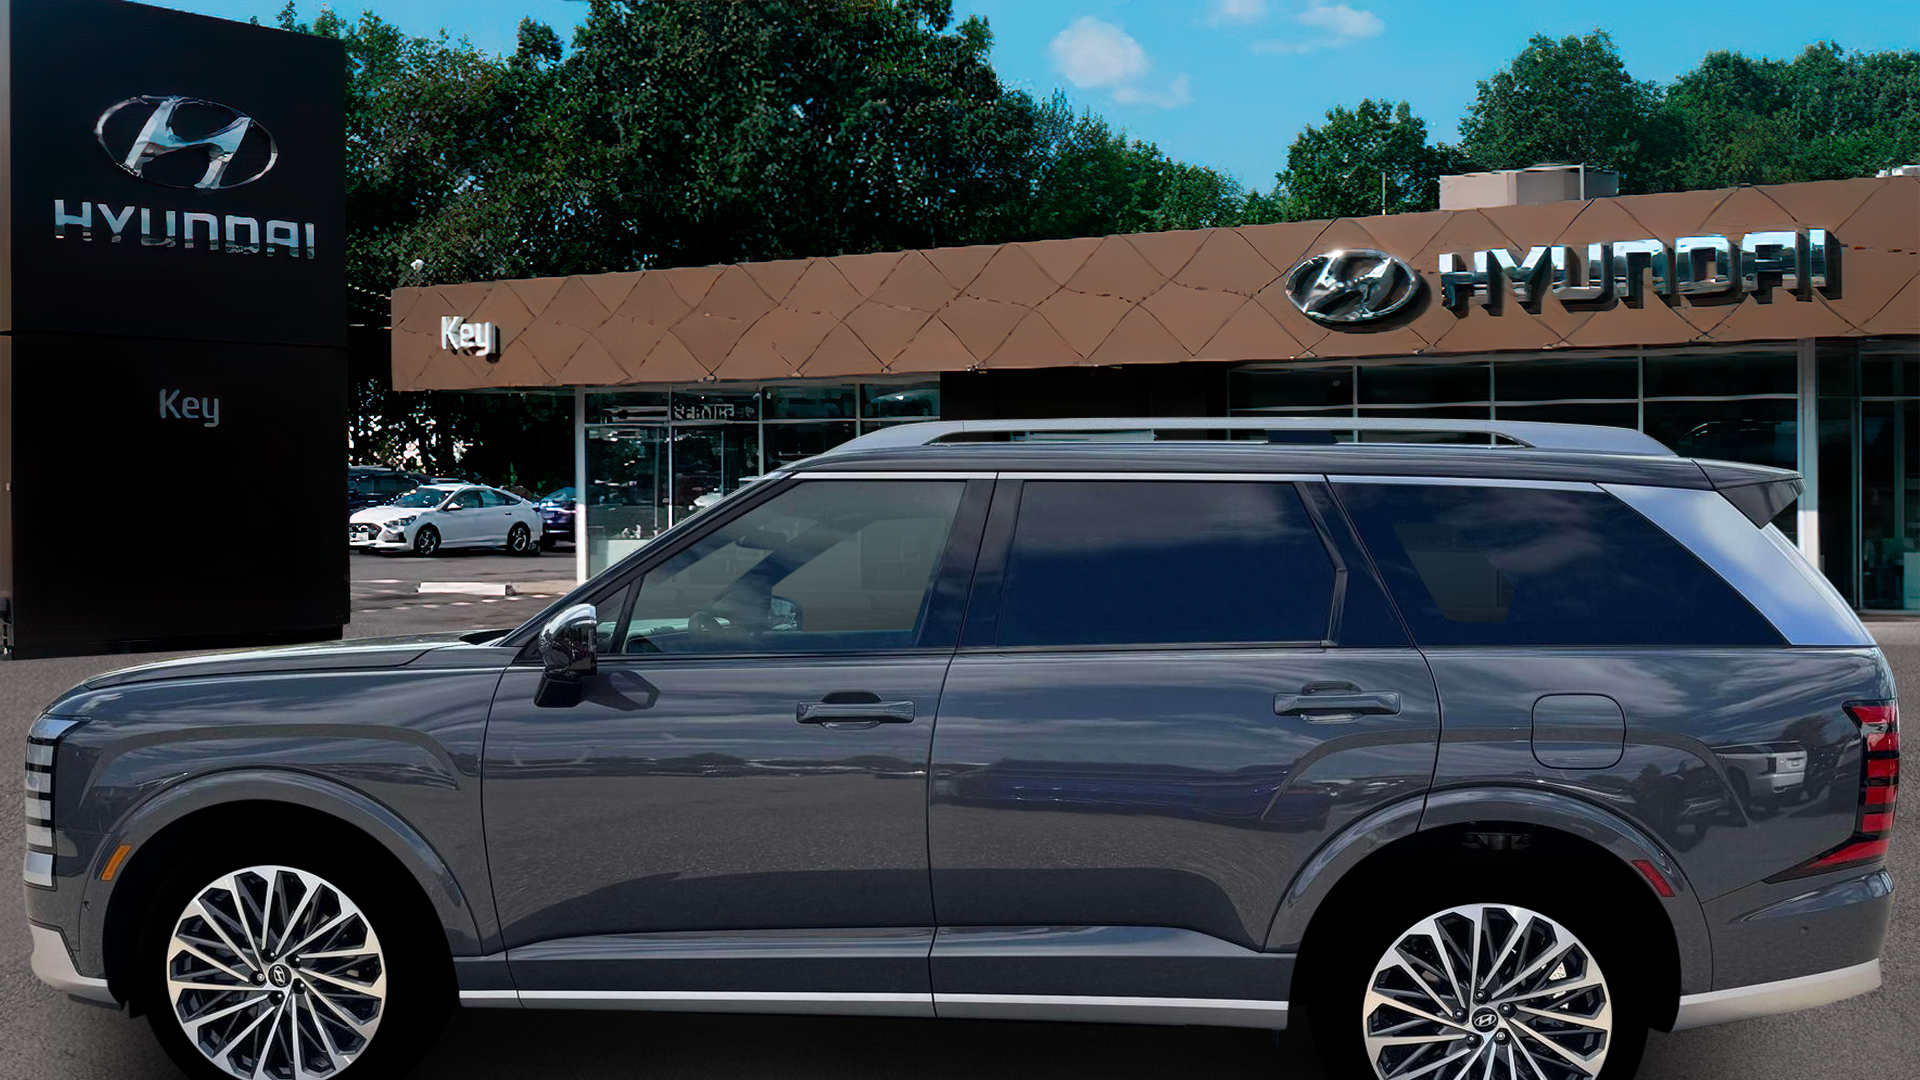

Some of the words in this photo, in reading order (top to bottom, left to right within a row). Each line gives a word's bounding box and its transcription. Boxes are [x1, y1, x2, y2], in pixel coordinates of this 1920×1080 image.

[54, 199, 315, 259] HYUNDAI
[1438, 228, 1838, 307] HYUNDAI
[441, 316, 494, 357] Key
[159, 388, 220, 428] Key
